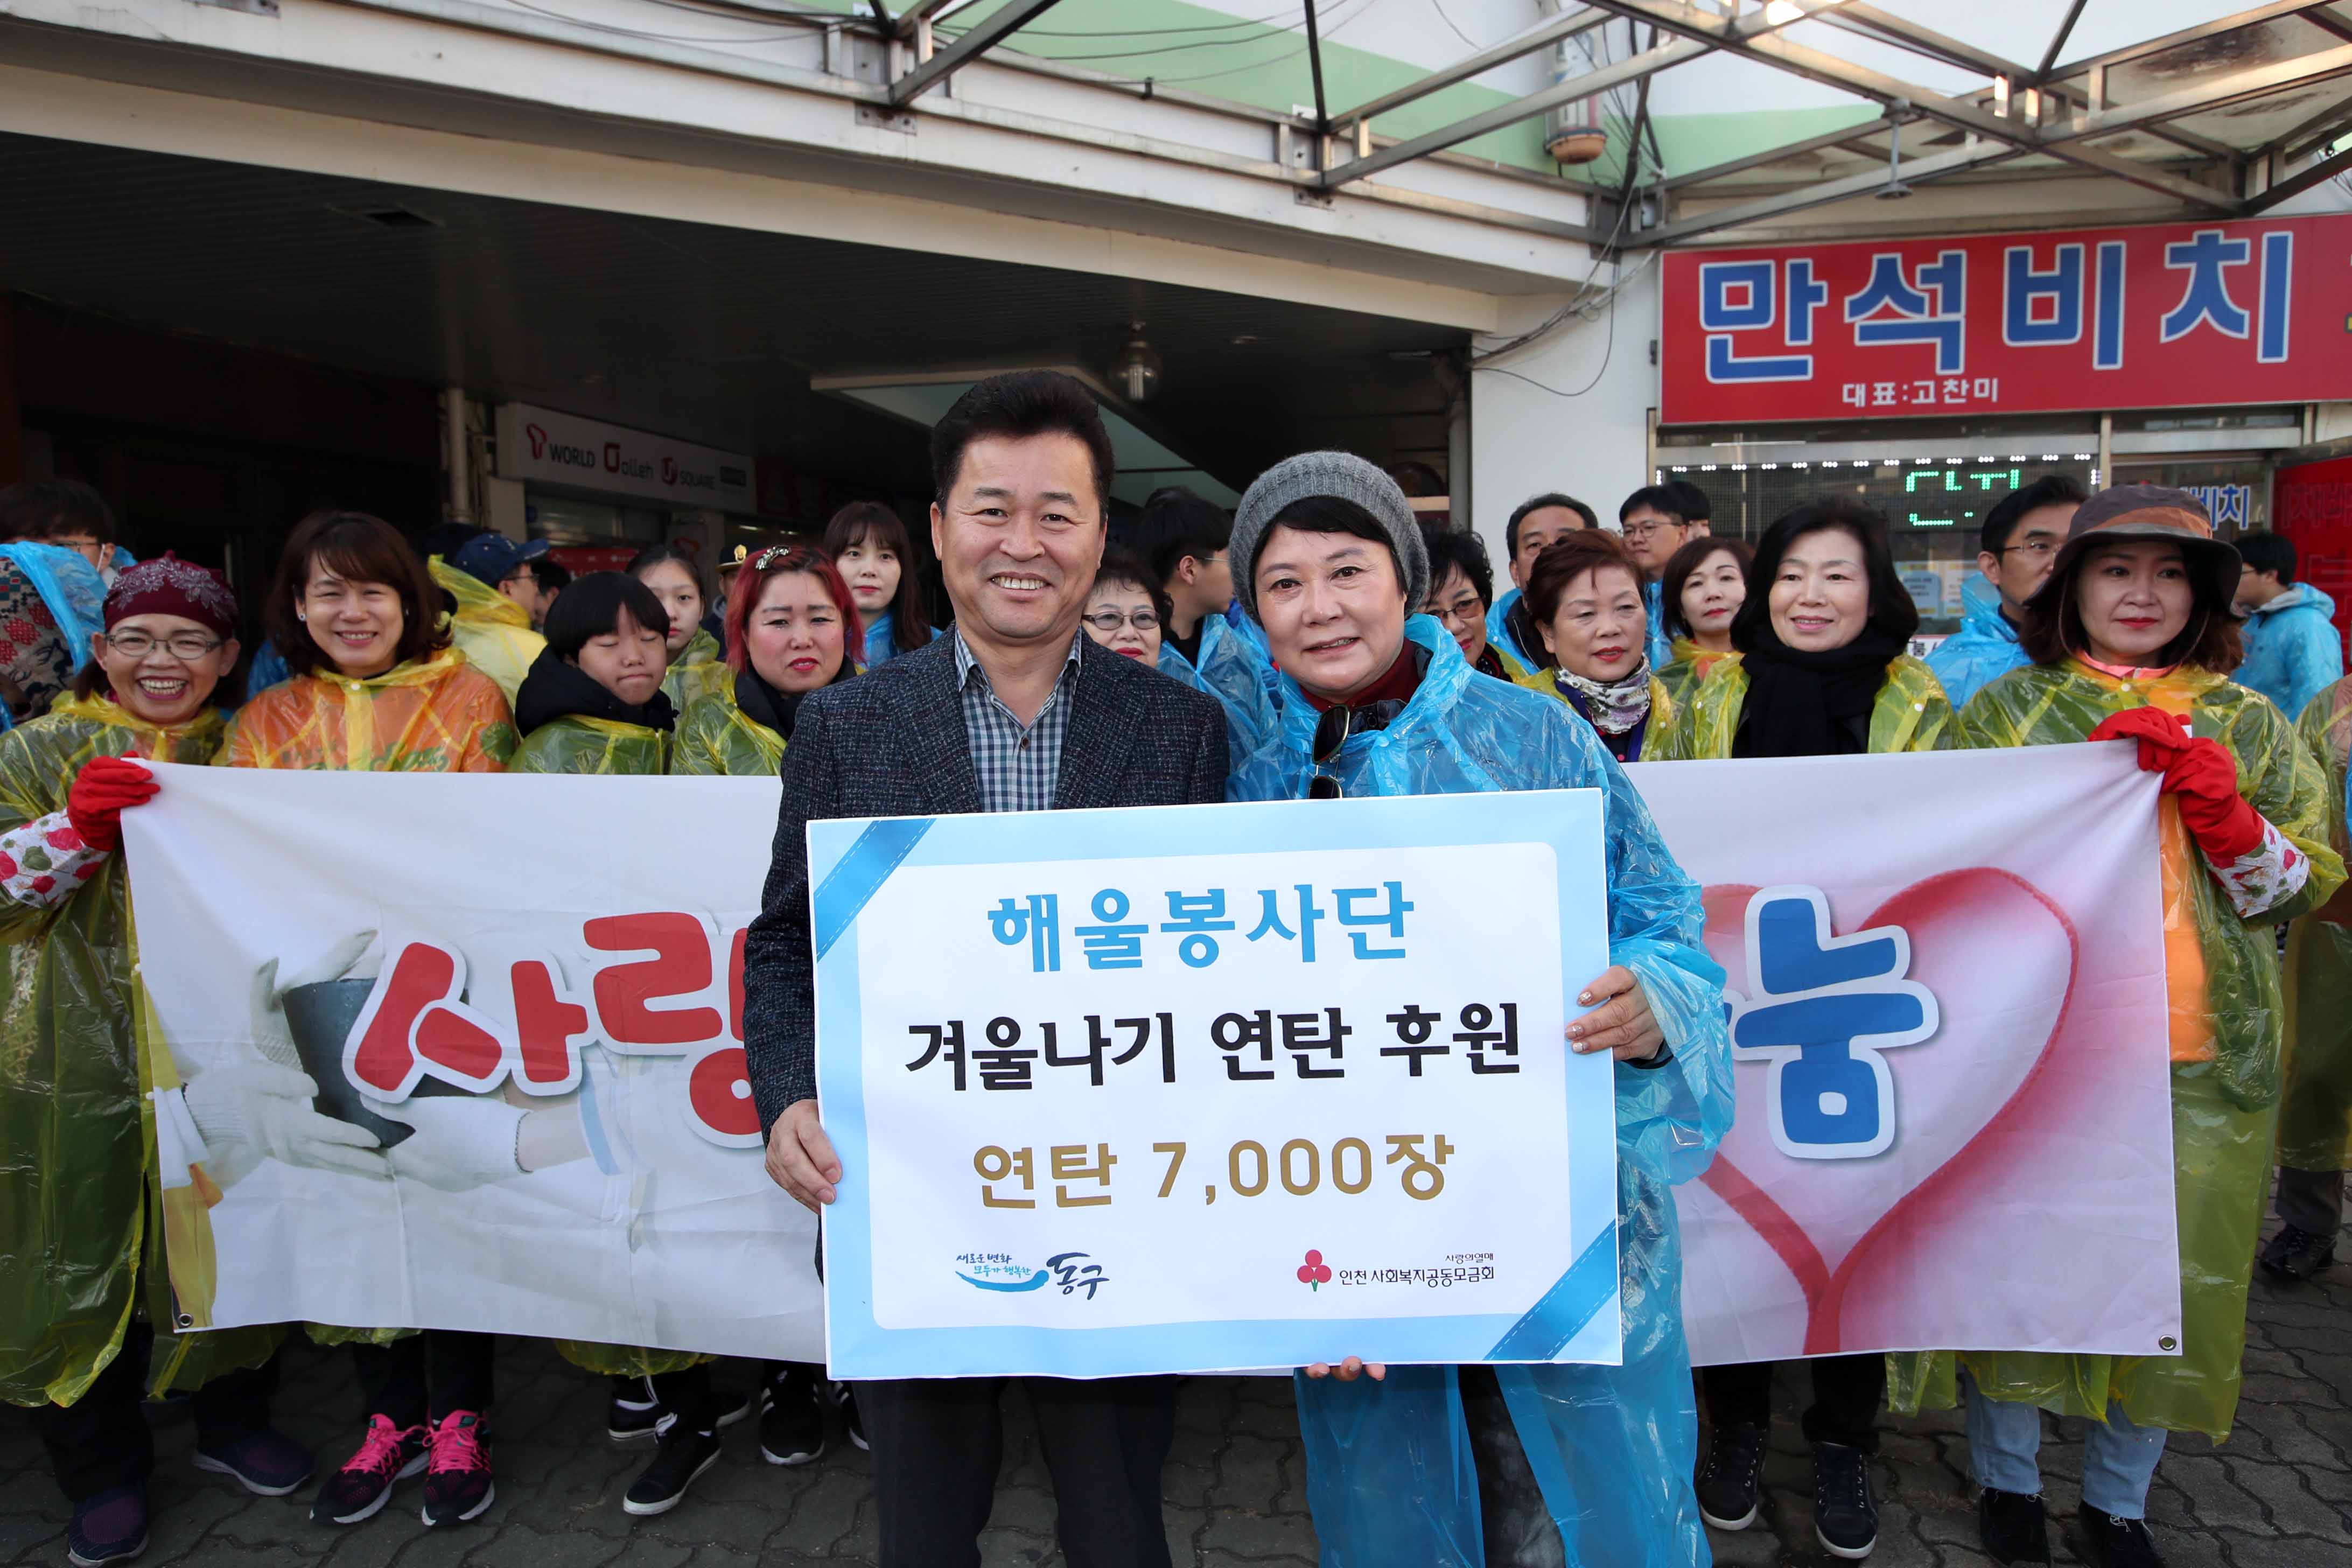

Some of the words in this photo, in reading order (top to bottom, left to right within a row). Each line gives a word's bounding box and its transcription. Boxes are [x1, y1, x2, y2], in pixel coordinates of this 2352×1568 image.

[1699, 229, 2296, 384] 만석비치
[1842, 377, 1999, 408] 대표:고찬미
[549, 444, 595, 468] WORLD
[988, 881, 1415, 972] 해울봉사단
[1724, 886, 1938, 1158] 눔
[905, 1012, 1175, 1091] 겨울나기
[1210, 1007, 1352, 1081] 연탄
[1380, 1003, 1520, 1077] 후원
[974, 1143, 1117, 1209] 연탄
[1152, 1134, 1455, 1206] 7,000장
[956, 1253, 985, 1264] 새로운
[987, 1253, 1012, 1264] 변화
[974, 1265, 1001, 1277] 모두가
[1002, 1264, 1032, 1279] 행복한
[1046, 1252, 1110, 1300] 동구
[1339, 1270, 1367, 1285] 인천
[1370, 1266, 1494, 1288] 사회복지공동모금회
[1445, 1252, 1494, 1264] 사랑의열매
